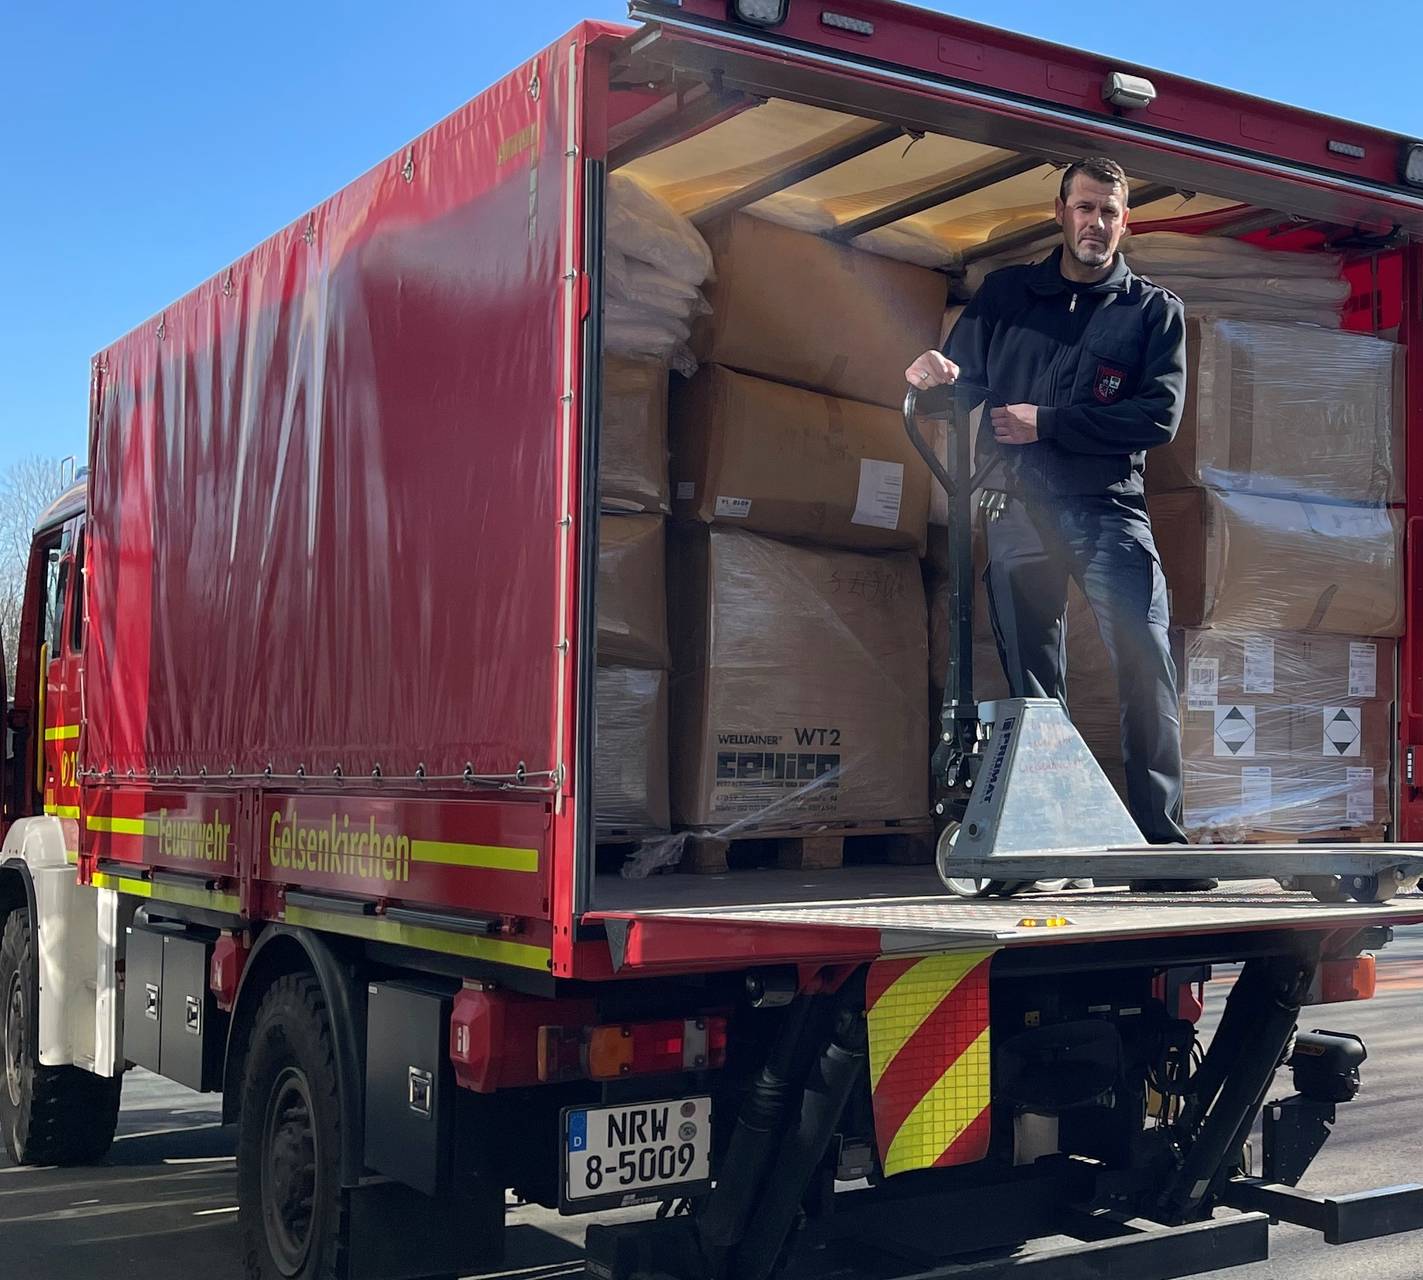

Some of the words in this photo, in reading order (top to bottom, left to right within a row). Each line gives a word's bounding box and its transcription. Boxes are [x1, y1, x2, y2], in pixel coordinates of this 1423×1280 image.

[794, 727, 841, 746] WT2
[158, 808, 231, 863] Feuerwehr
[269, 810, 410, 882] Gelsenkirchen
[573, 1136, 582, 1147] D
[607, 1107, 669, 1148] NRW
[585, 1143, 695, 1190] 8-5009
